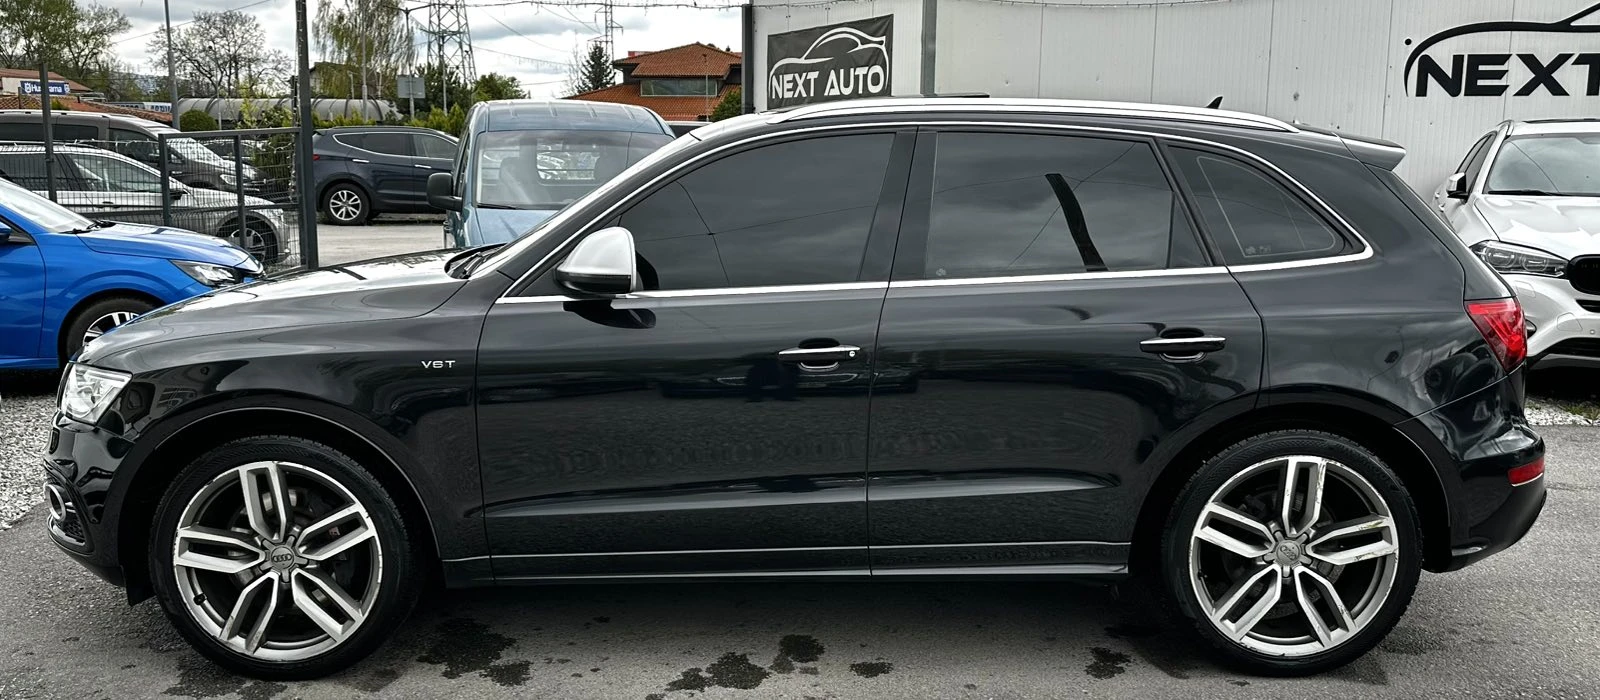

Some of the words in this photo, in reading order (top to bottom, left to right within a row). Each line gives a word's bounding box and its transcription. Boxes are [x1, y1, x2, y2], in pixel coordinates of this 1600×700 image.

[771, 70, 820, 99] NEXT
[823, 64, 885, 97] AUTO
[1415, 53, 1600, 98] NEXT
[420, 360, 456, 369] V6T
